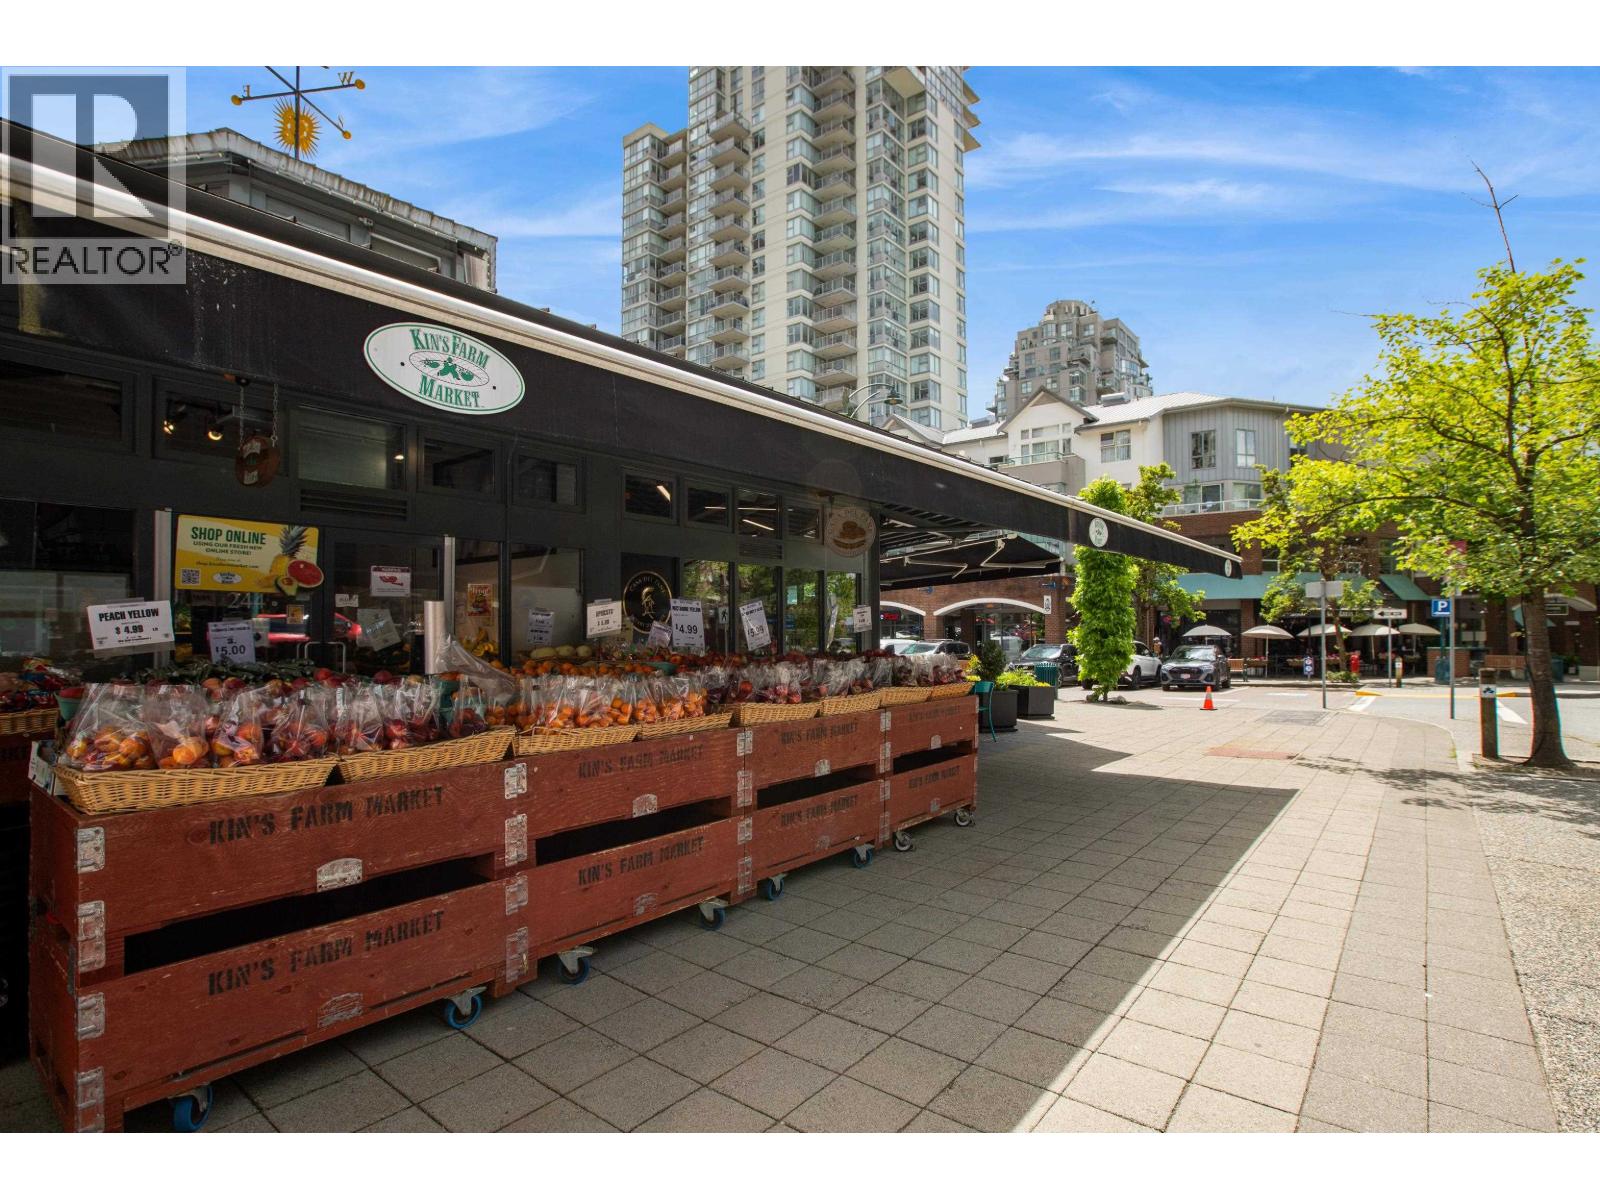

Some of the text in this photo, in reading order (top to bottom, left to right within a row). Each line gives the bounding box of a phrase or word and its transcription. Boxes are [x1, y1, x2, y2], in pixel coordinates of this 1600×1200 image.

[452, 335, 490, 368] FARM
[419, 375, 481, 408] MARKET
[191, 526, 267, 545] SHOP ONLINE
[98, 608, 159, 622] PEACH YELLOW
[1438, 600, 1448, 611] P
[124, 624, 144, 634] 4.99
[209, 786, 443, 845] KIN'S FARM MARKET
[620, 851, 653, 873] FARM
[208, 911, 444, 996] KIN'S FARM MARKET
